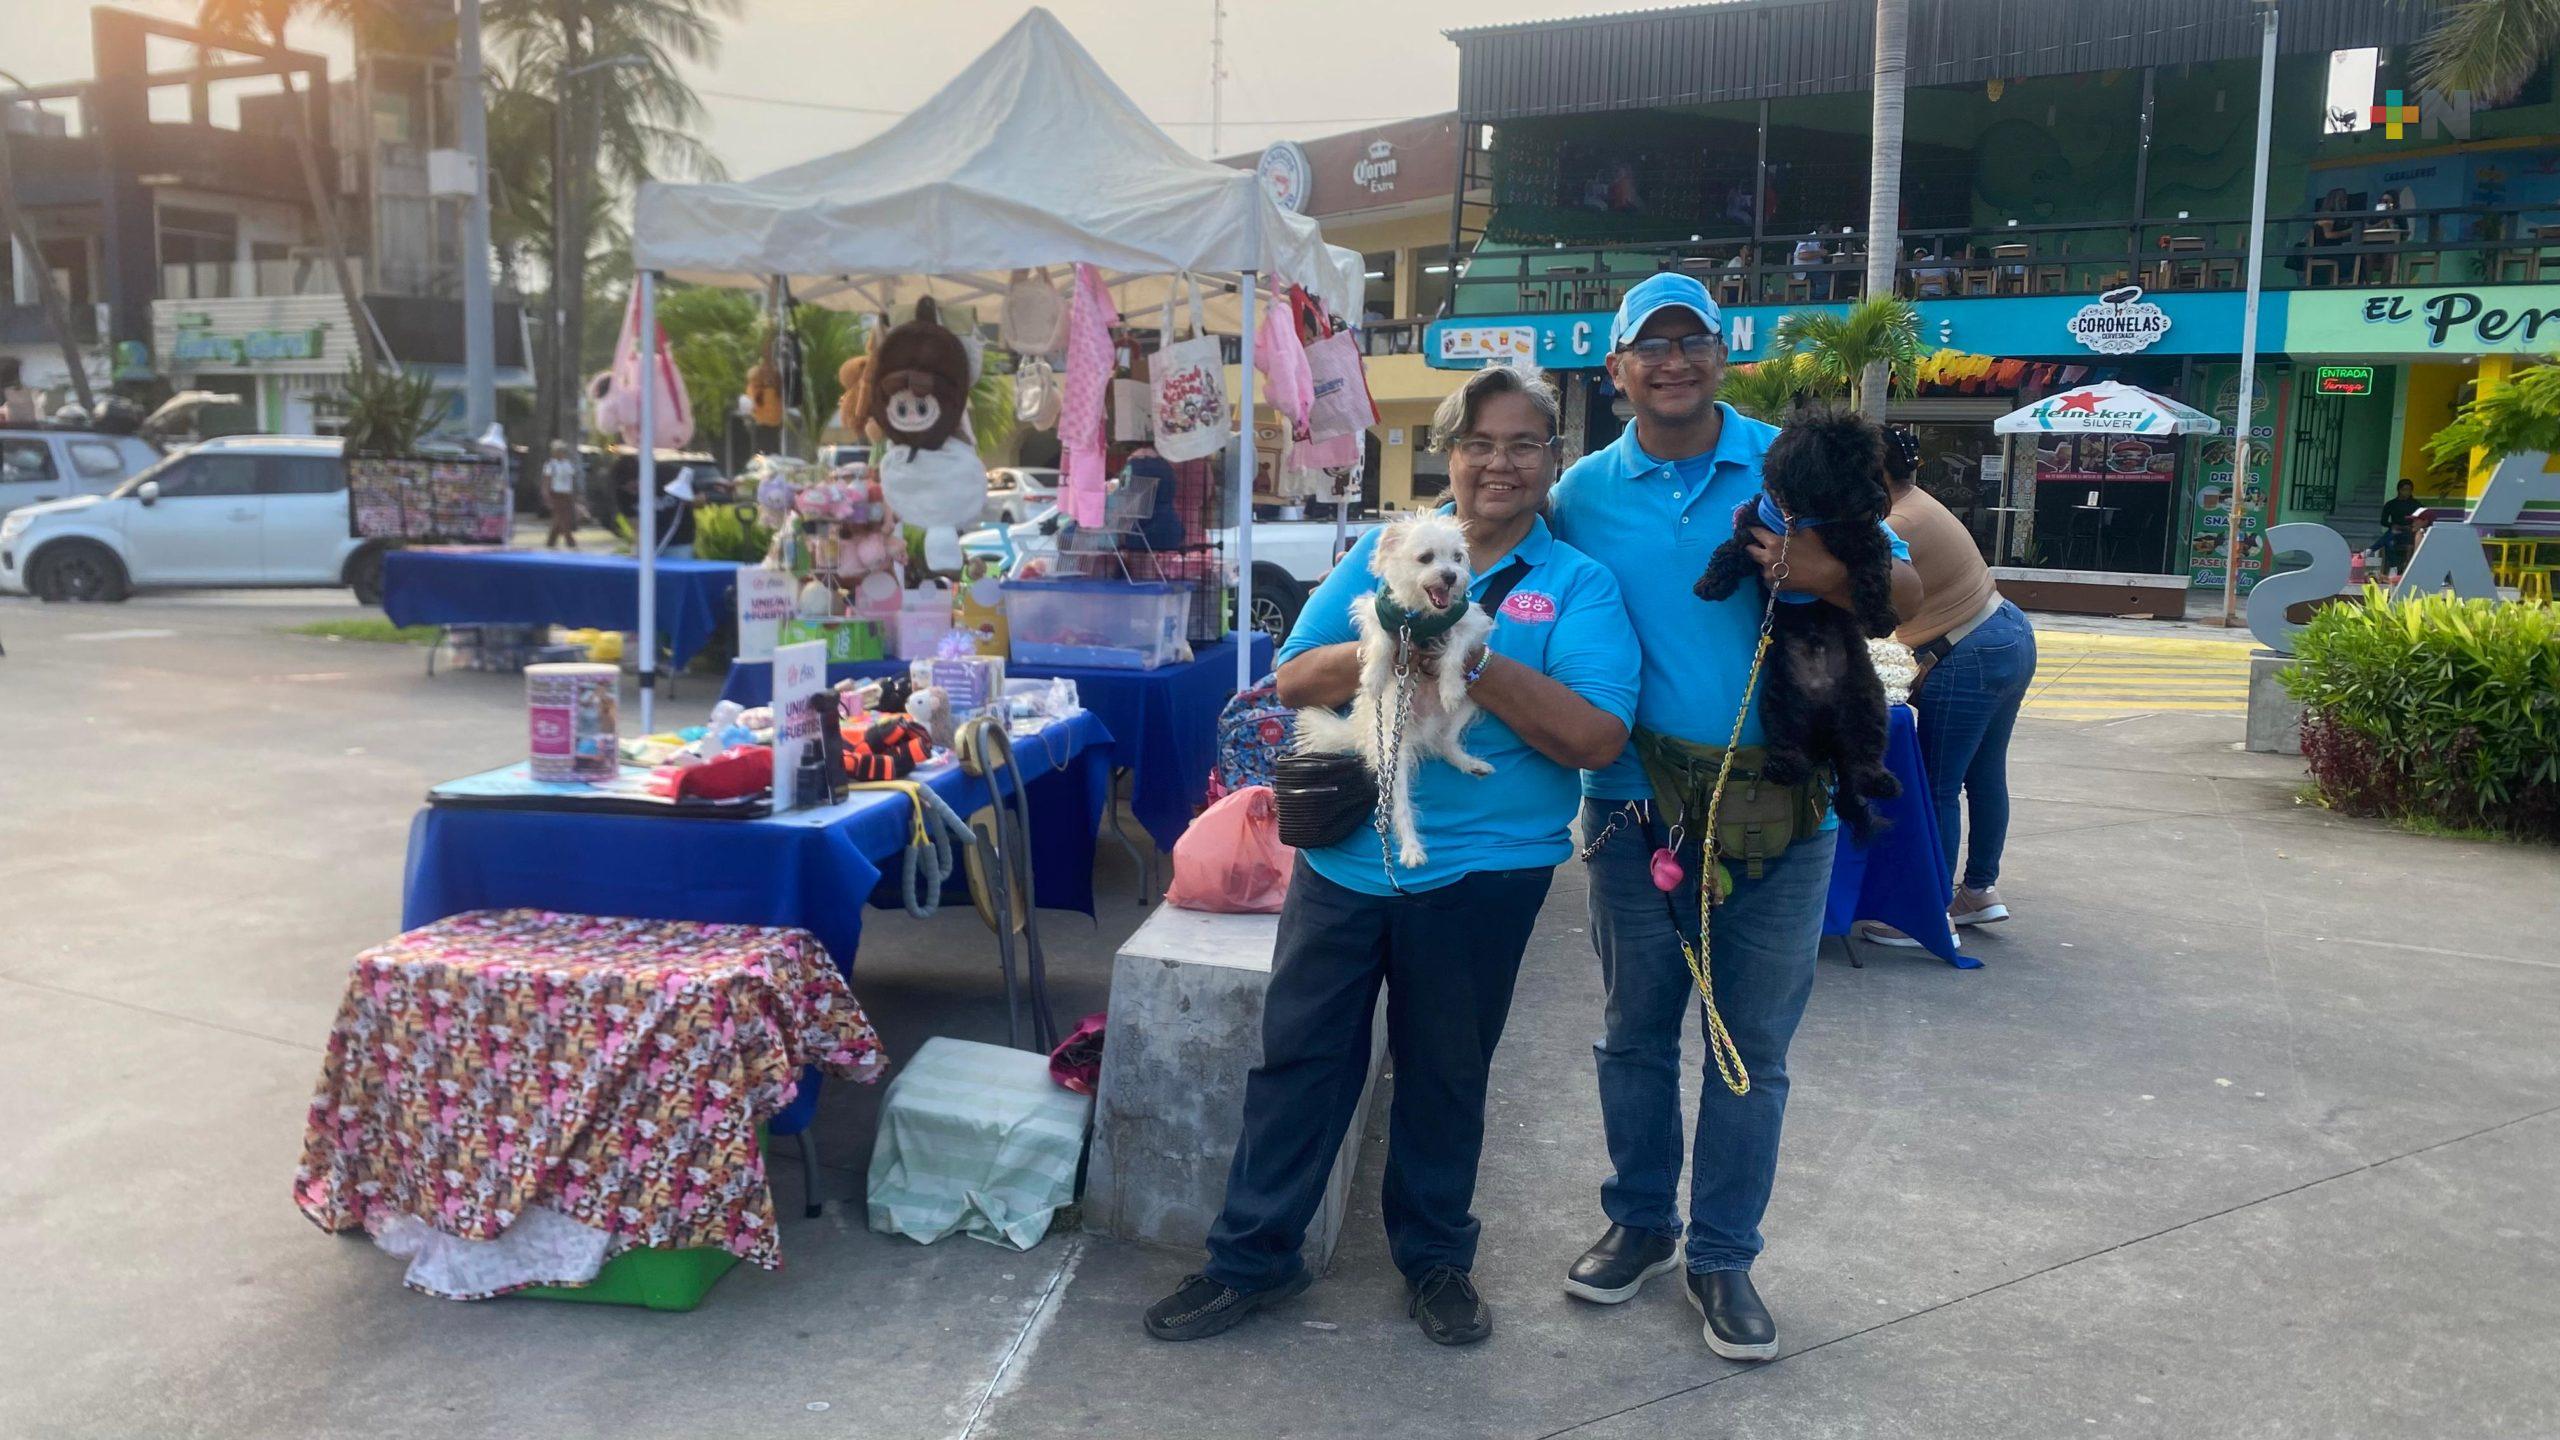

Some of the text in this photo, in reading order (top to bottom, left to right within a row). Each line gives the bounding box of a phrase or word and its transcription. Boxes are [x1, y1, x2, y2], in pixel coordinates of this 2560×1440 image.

[2078, 316, 2161, 333] CORONELAS
[2322, 369, 2368, 378] ENTRADA
[2030, 407, 2143, 419] Heineken
[2083, 418, 2131, 429] SILVER
